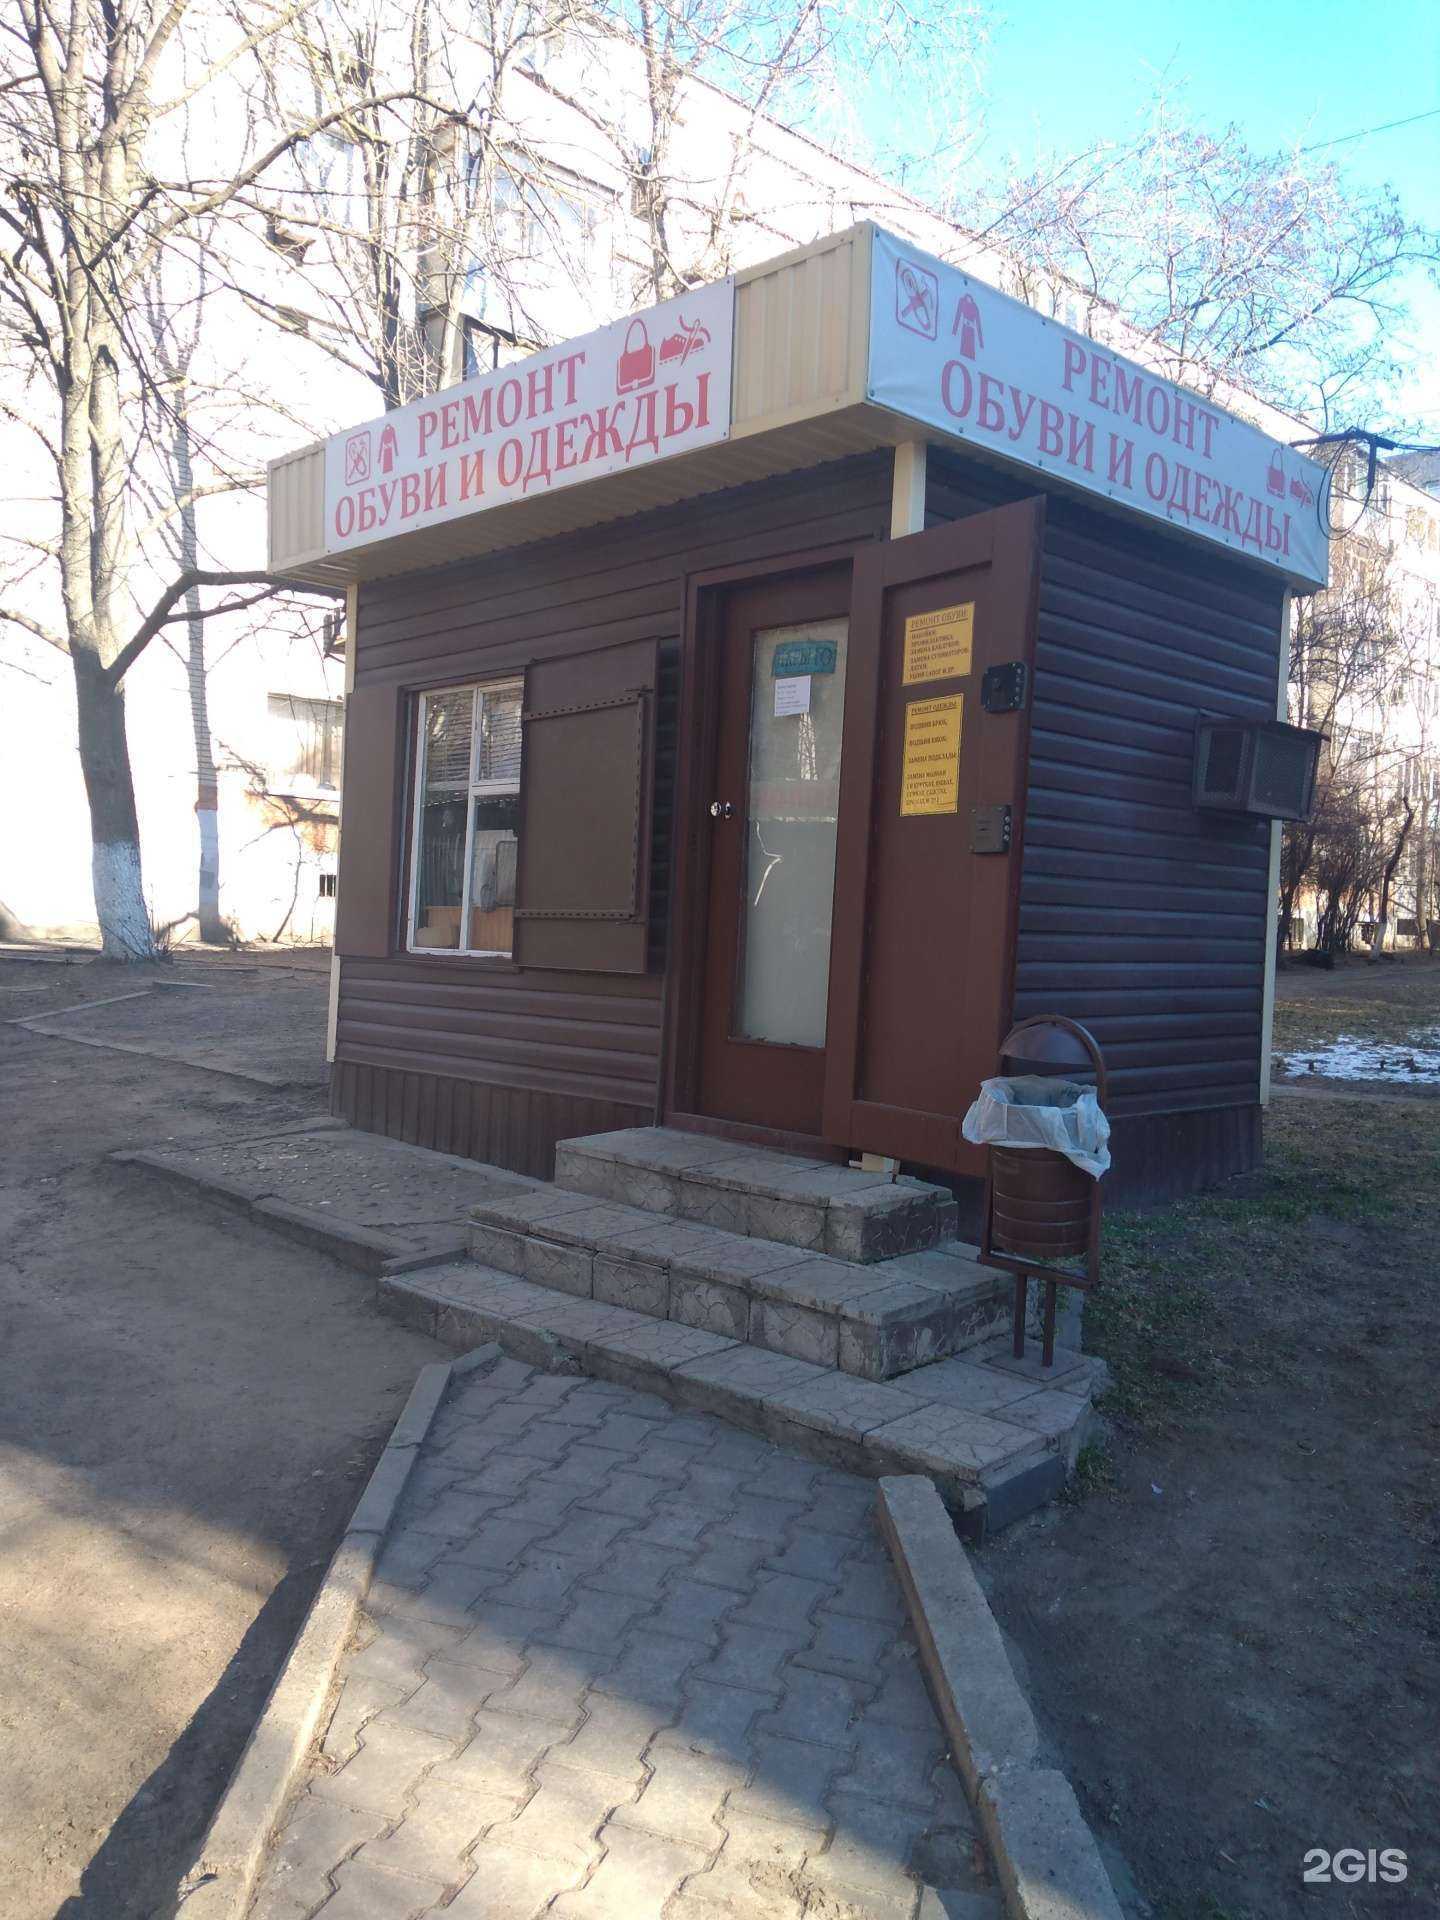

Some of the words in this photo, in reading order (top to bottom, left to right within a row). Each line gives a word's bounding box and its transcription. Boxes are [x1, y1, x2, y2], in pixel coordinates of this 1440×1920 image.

[335, 475, 447, 539] ОБУВИ
[459, 449, 486, 501] И
[498, 371, 711, 493] ОДЕЖДЫ
[417, 351, 586, 458] РЕМОНТ
[940, 359, 1096, 473] ОБУВИ
[1107, 432, 1134, 490] И
[1144, 451, 1292, 556] ОДЕЖДЫ
[1062, 338, 1219, 460] РЕМОНТ
